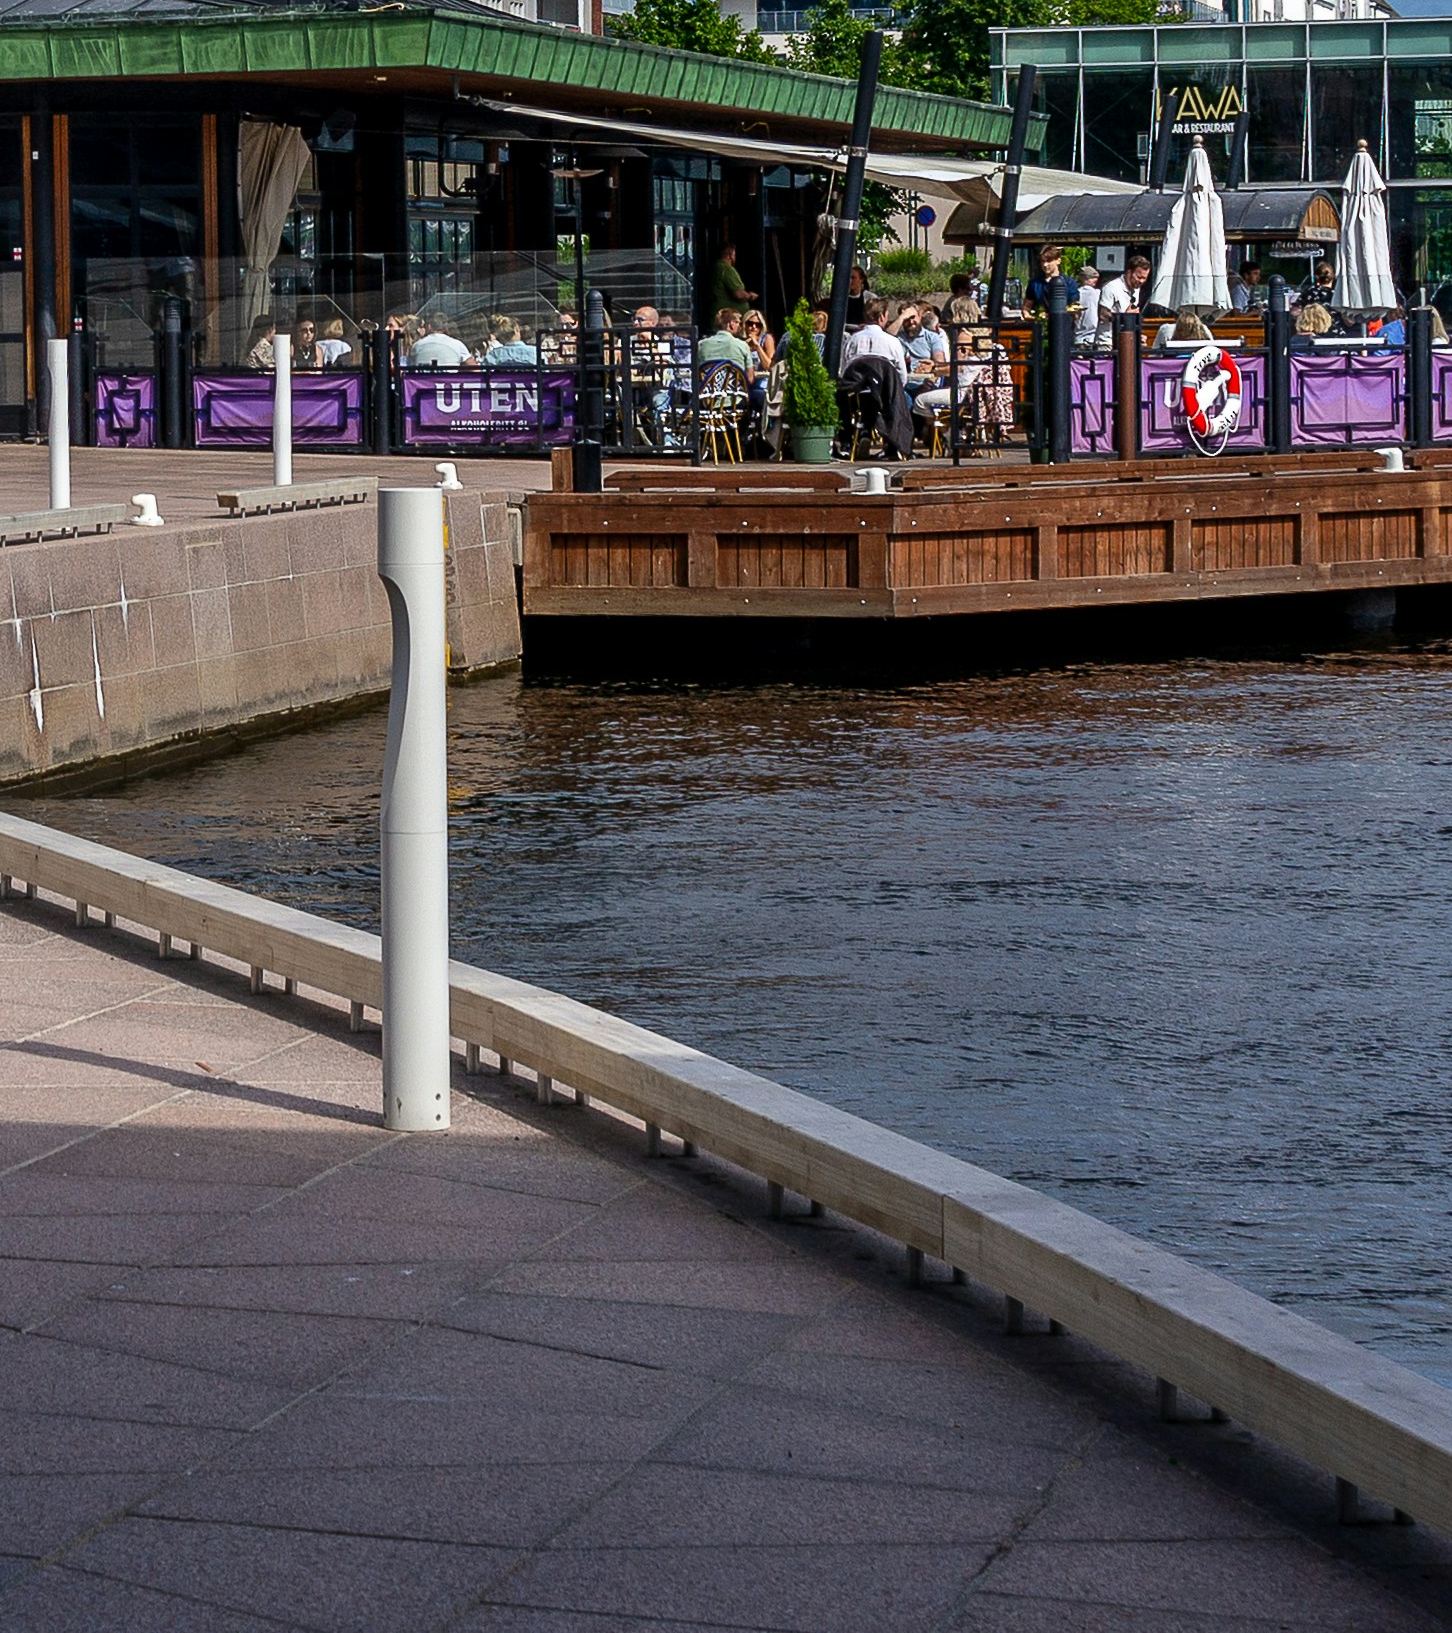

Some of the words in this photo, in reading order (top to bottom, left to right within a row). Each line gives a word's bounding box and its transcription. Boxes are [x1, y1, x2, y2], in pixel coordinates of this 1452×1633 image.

[1171, 123, 1183, 134] AR
[1184, 123, 1190, 134] &
[1191, 122, 1235, 134] RESTAURANT
[435, 382, 538, 413] UTEN
